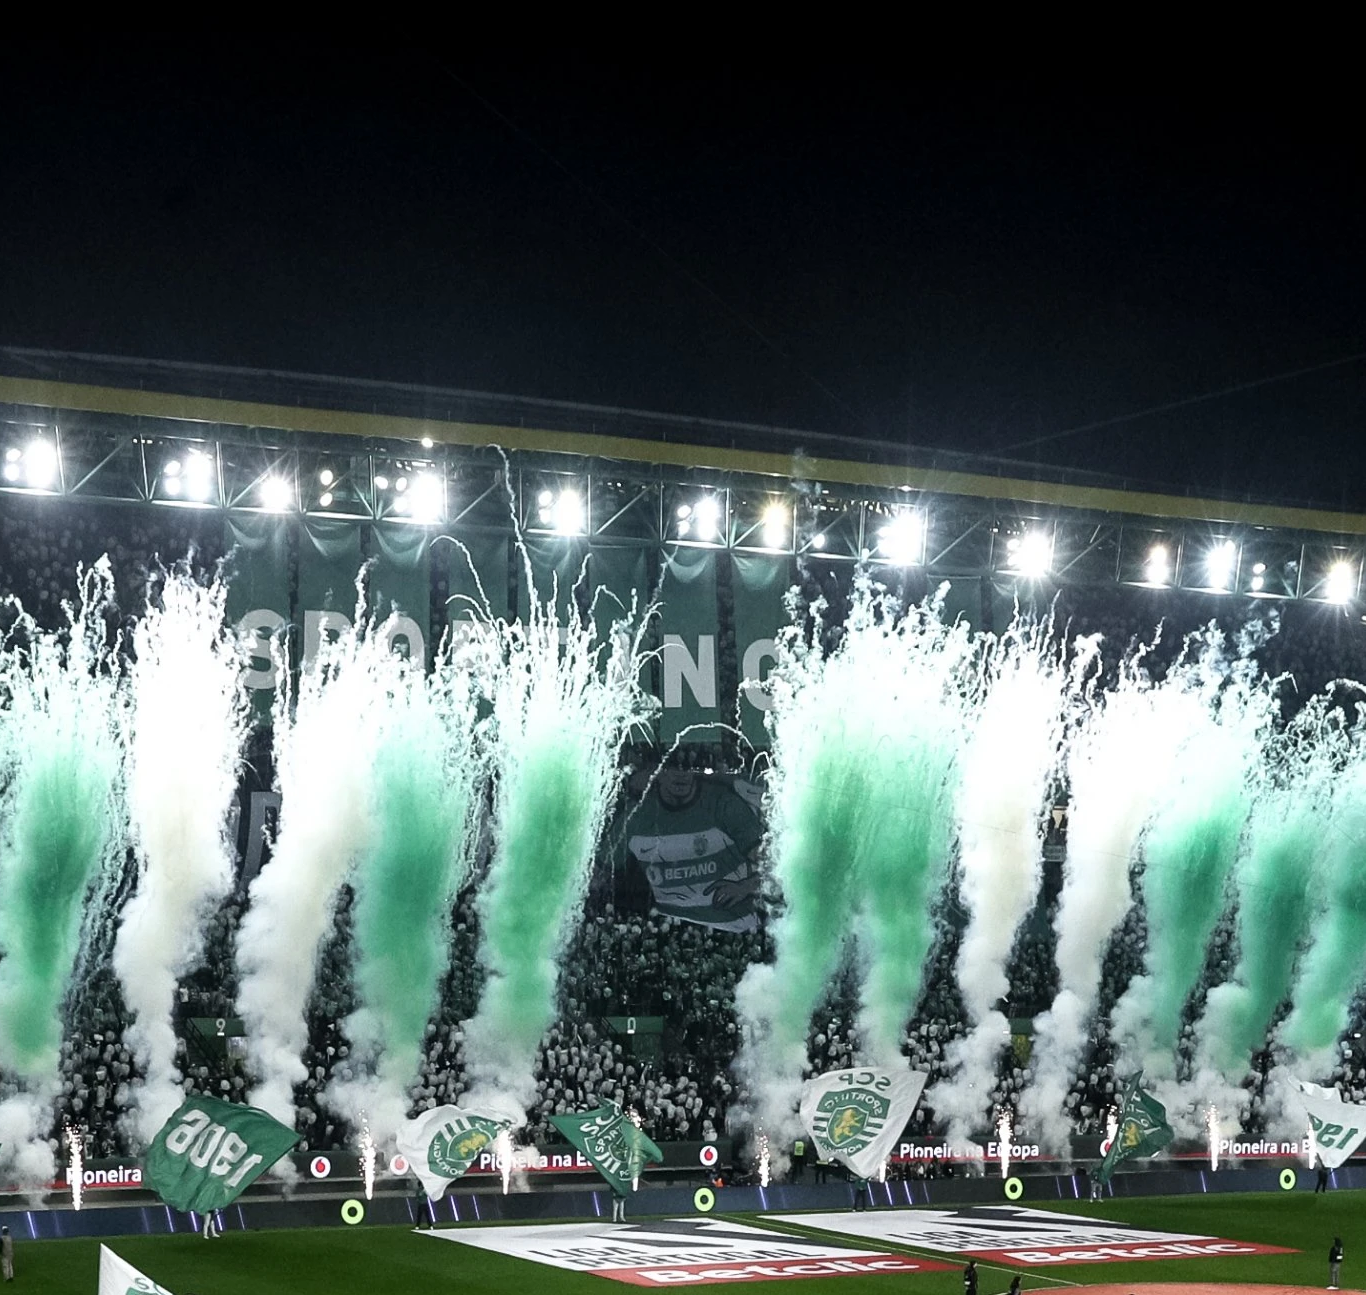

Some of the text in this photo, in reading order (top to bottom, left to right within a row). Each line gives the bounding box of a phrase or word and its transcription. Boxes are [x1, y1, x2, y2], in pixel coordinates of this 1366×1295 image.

[664, 861, 718, 880] BETANO
[1218, 1138, 1278, 1156] Pioneira
[1281, 1141, 1299, 1154] na
[552, 1154, 572, 1167] na
[1003, 1242, 1258, 1264] Betclic
[636, 1259, 920, 1284] Betclic
